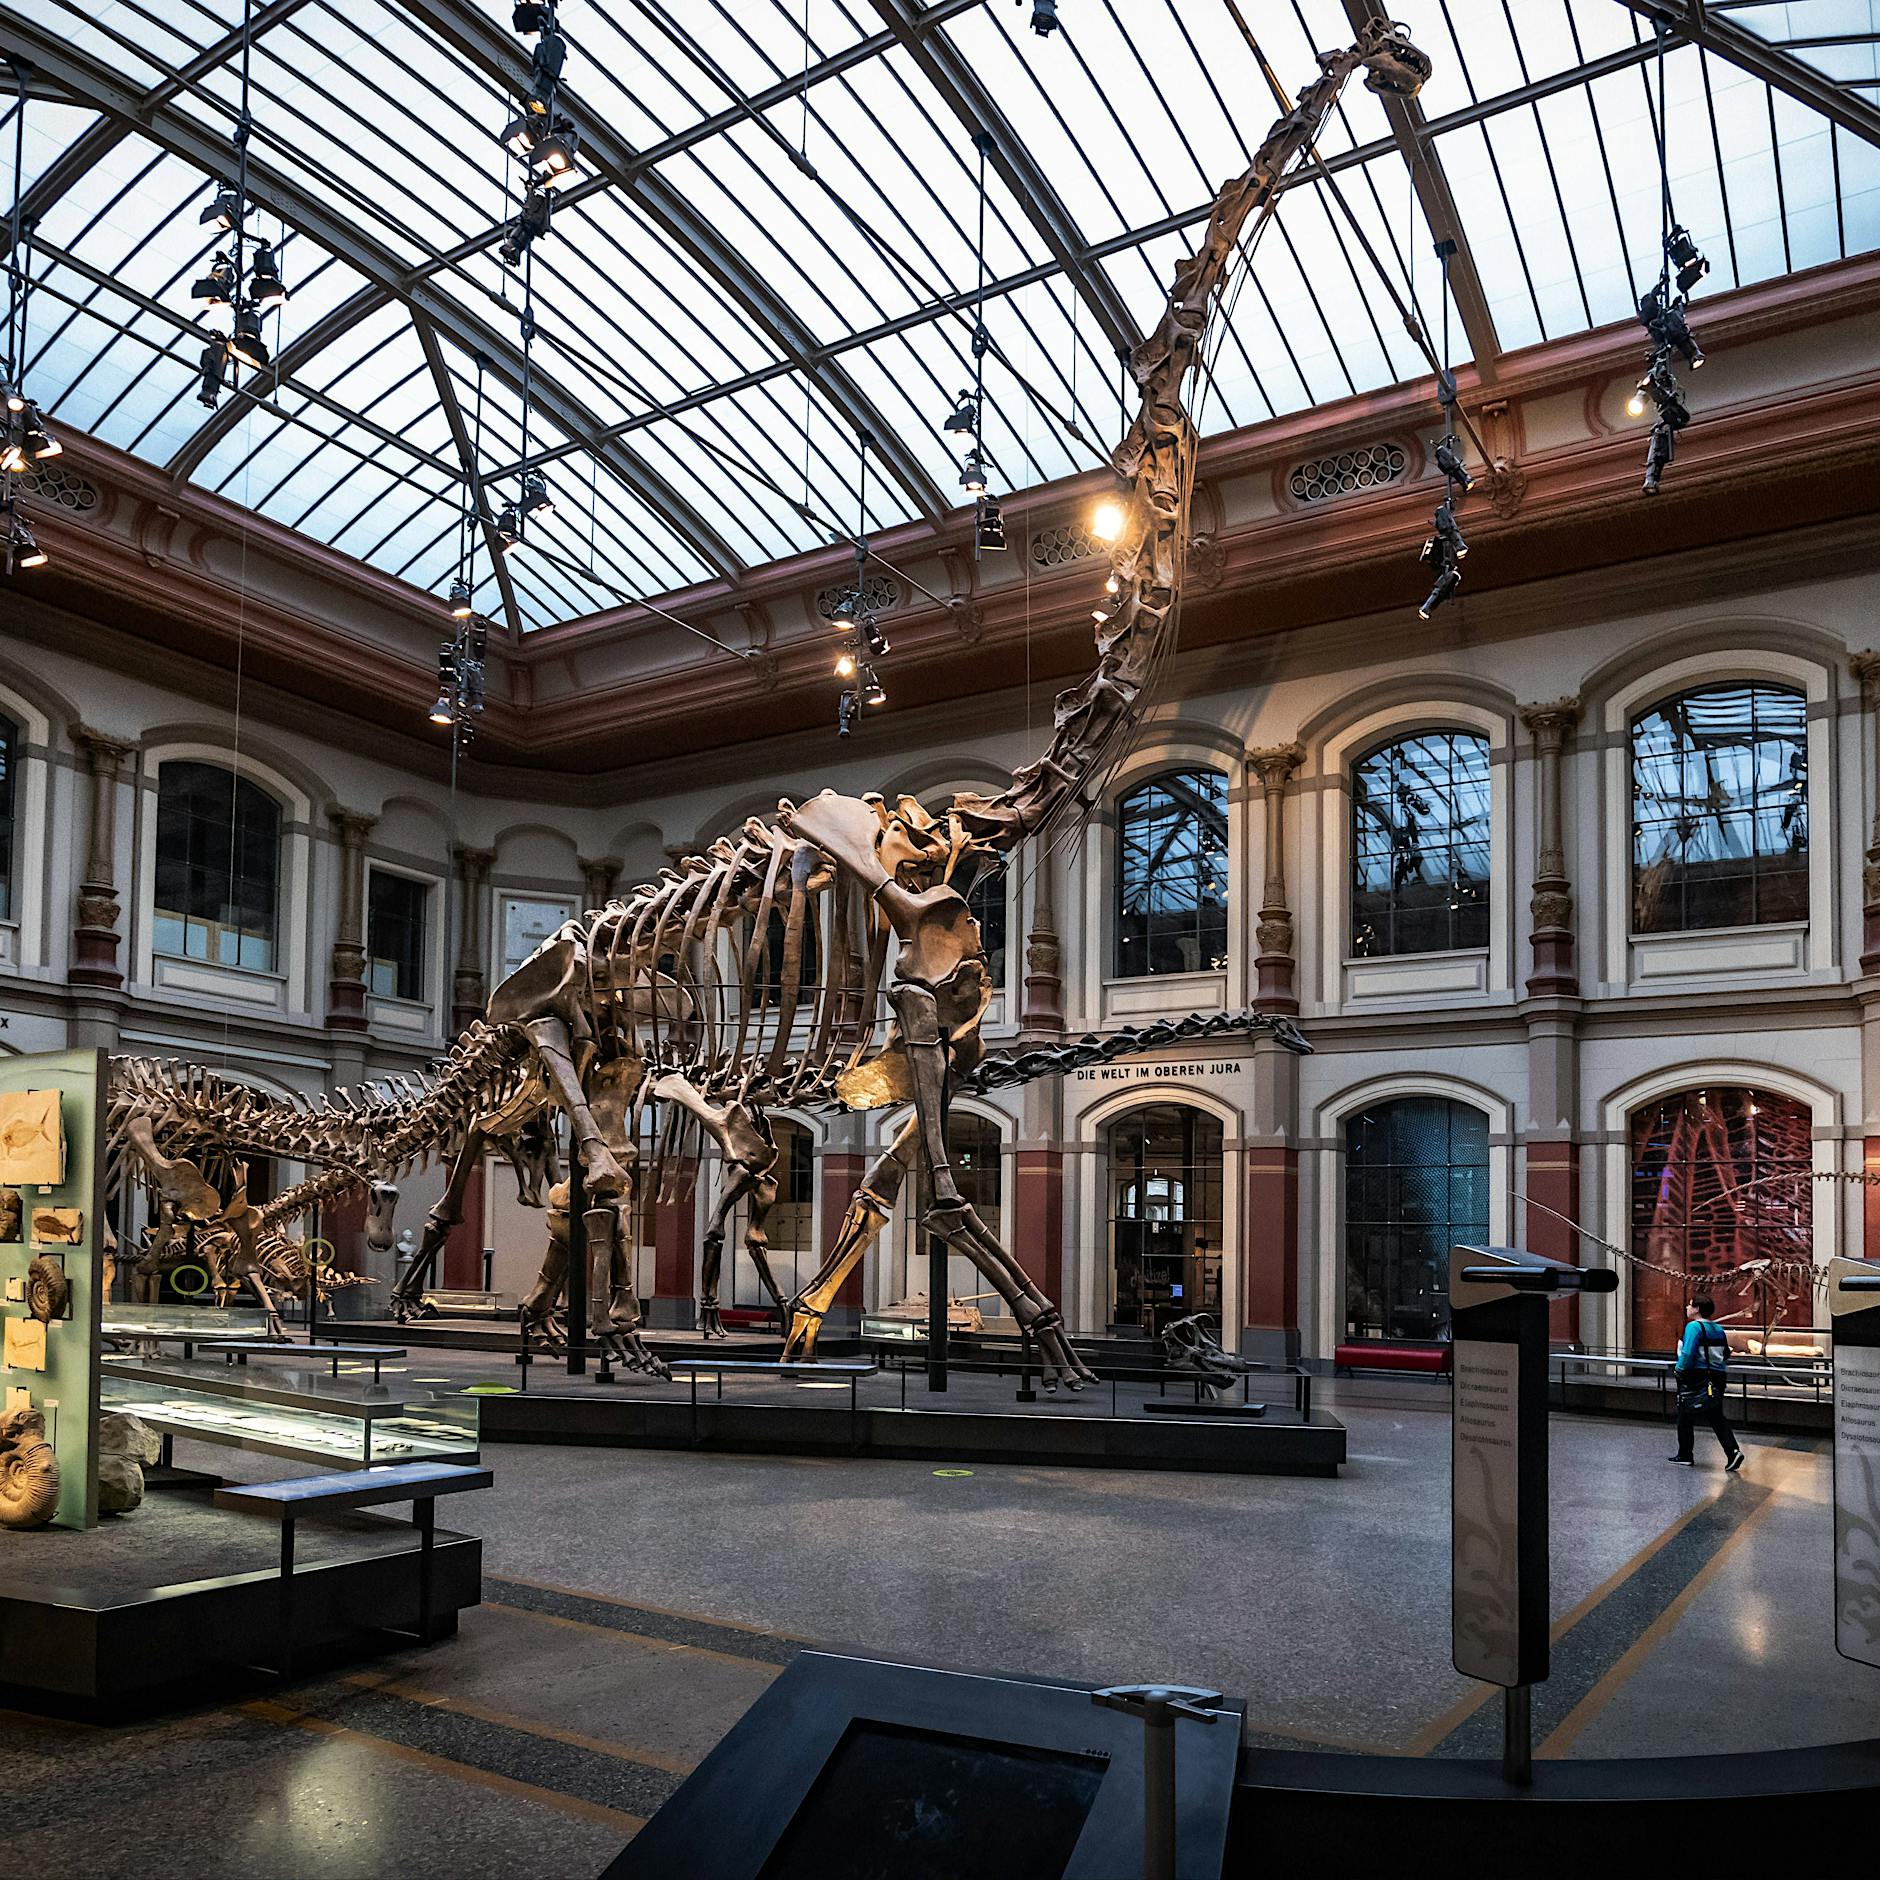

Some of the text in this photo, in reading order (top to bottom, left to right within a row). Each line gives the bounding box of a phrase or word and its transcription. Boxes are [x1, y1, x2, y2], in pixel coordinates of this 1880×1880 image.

[1077, 1062, 1241, 1080] DIE WELT IM OBEREN JURA
[1841, 1416, 1876, 1427] Allosaurus
